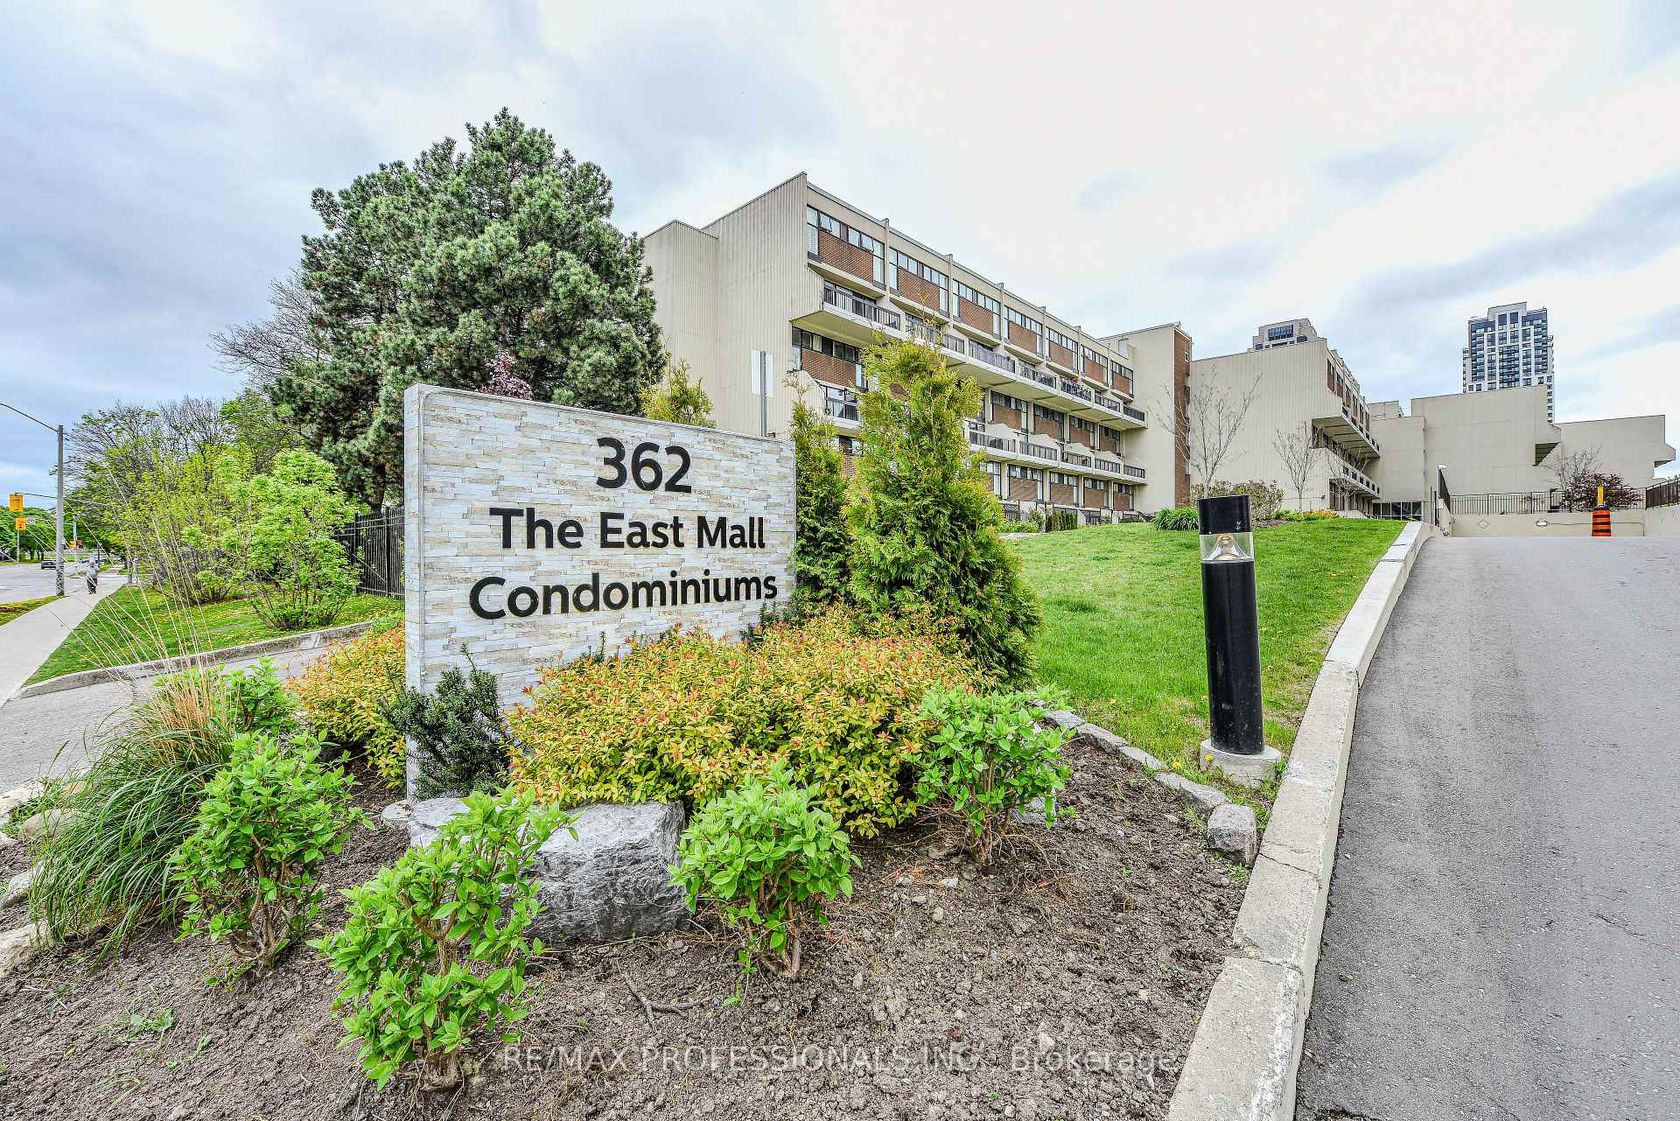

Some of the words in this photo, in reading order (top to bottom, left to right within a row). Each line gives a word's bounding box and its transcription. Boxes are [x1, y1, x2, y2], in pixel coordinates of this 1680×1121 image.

[596, 437, 692, 493] 362
[489, 507, 584, 549] The
[600, 512, 684, 549] East
[698, 516, 765, 549] Mall
[469, 568, 777, 620] Condominiums
